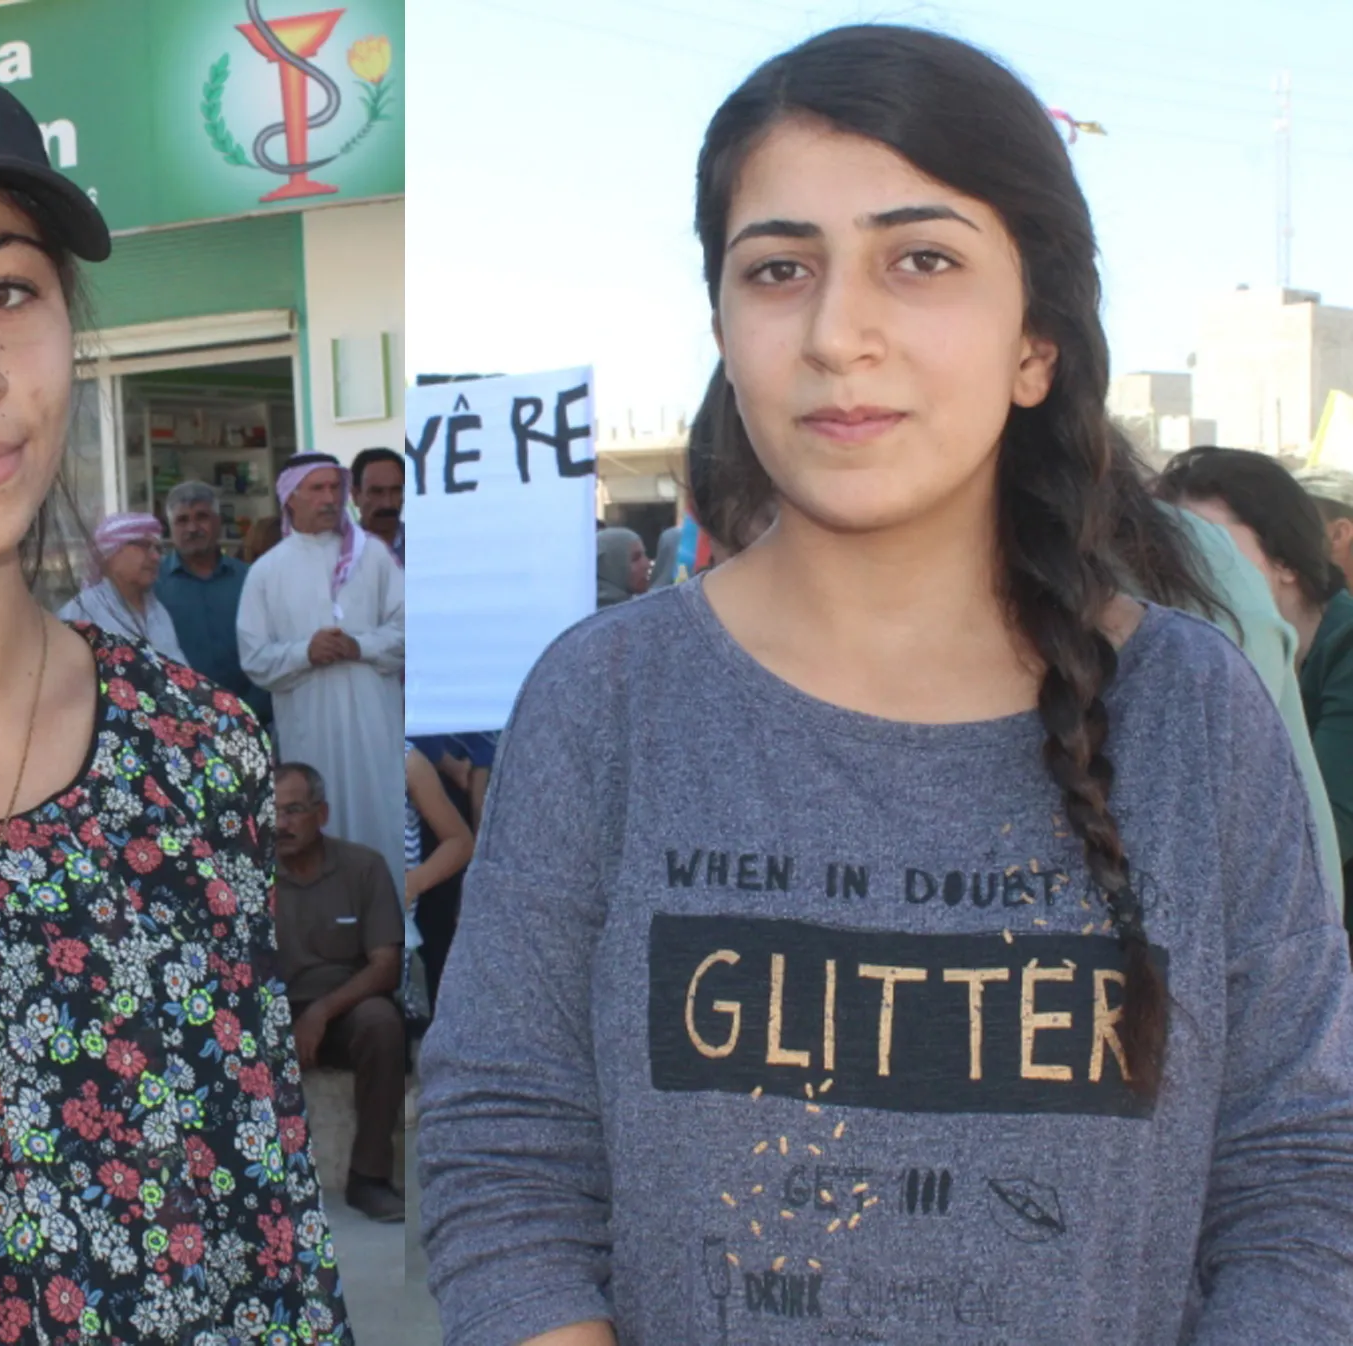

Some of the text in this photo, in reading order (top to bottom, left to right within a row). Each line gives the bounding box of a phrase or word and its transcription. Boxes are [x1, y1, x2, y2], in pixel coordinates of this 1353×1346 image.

[666, 848, 794, 892] WHEN
[826, 863, 869, 900] IN
[905, 867, 1064, 908] DOUBT
[685, 948, 1132, 1083] GLITTER
[745, 1268, 823, 1319] DRINK
